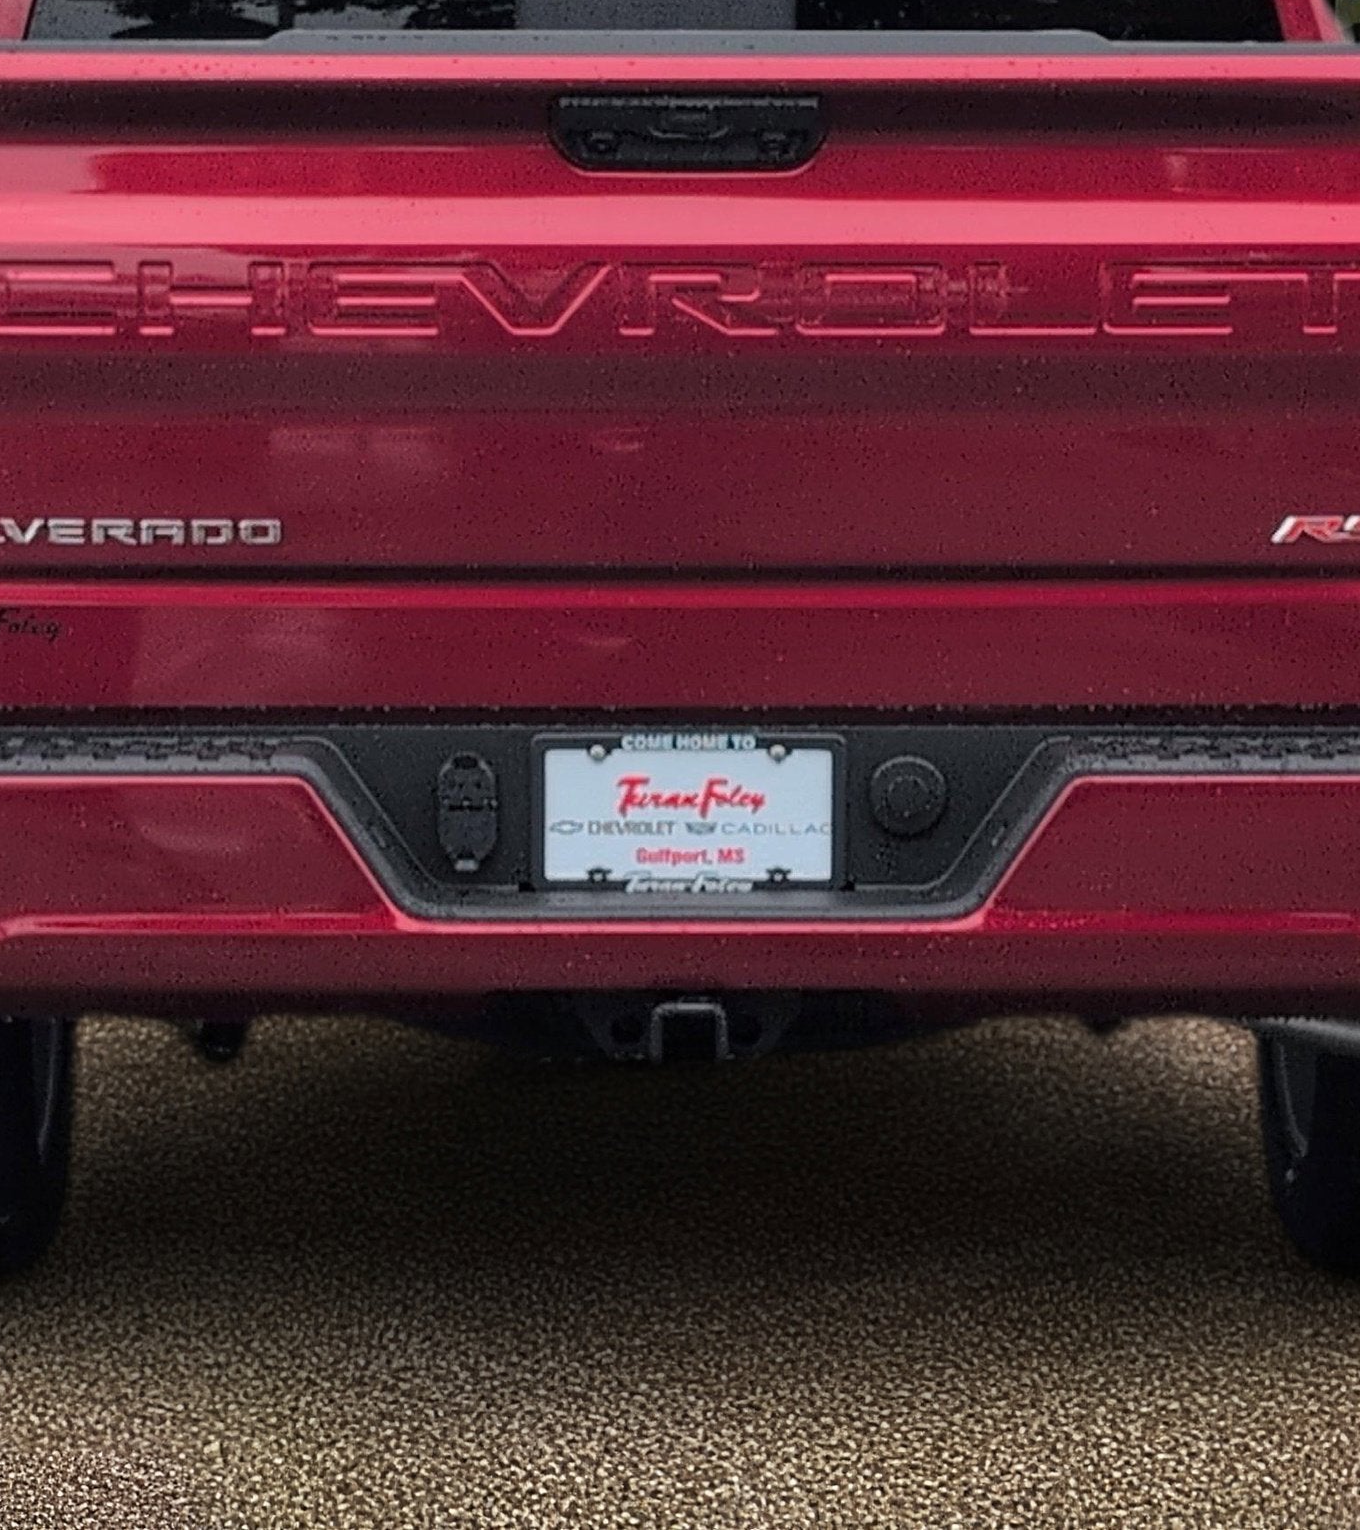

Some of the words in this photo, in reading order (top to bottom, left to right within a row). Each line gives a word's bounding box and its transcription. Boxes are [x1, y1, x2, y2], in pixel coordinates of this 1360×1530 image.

[621, 733, 673, 750] COME
[676, 733, 728, 750] HOME
[730, 734, 757, 750] TO
[698, 777, 766, 820] Foley
[588, 820, 675, 836] CHEVROLET
[721, 822, 830, 836] CADILLAC
[636, 848, 712, 866] Gulfport,
[717, 849, 746, 865] MS
